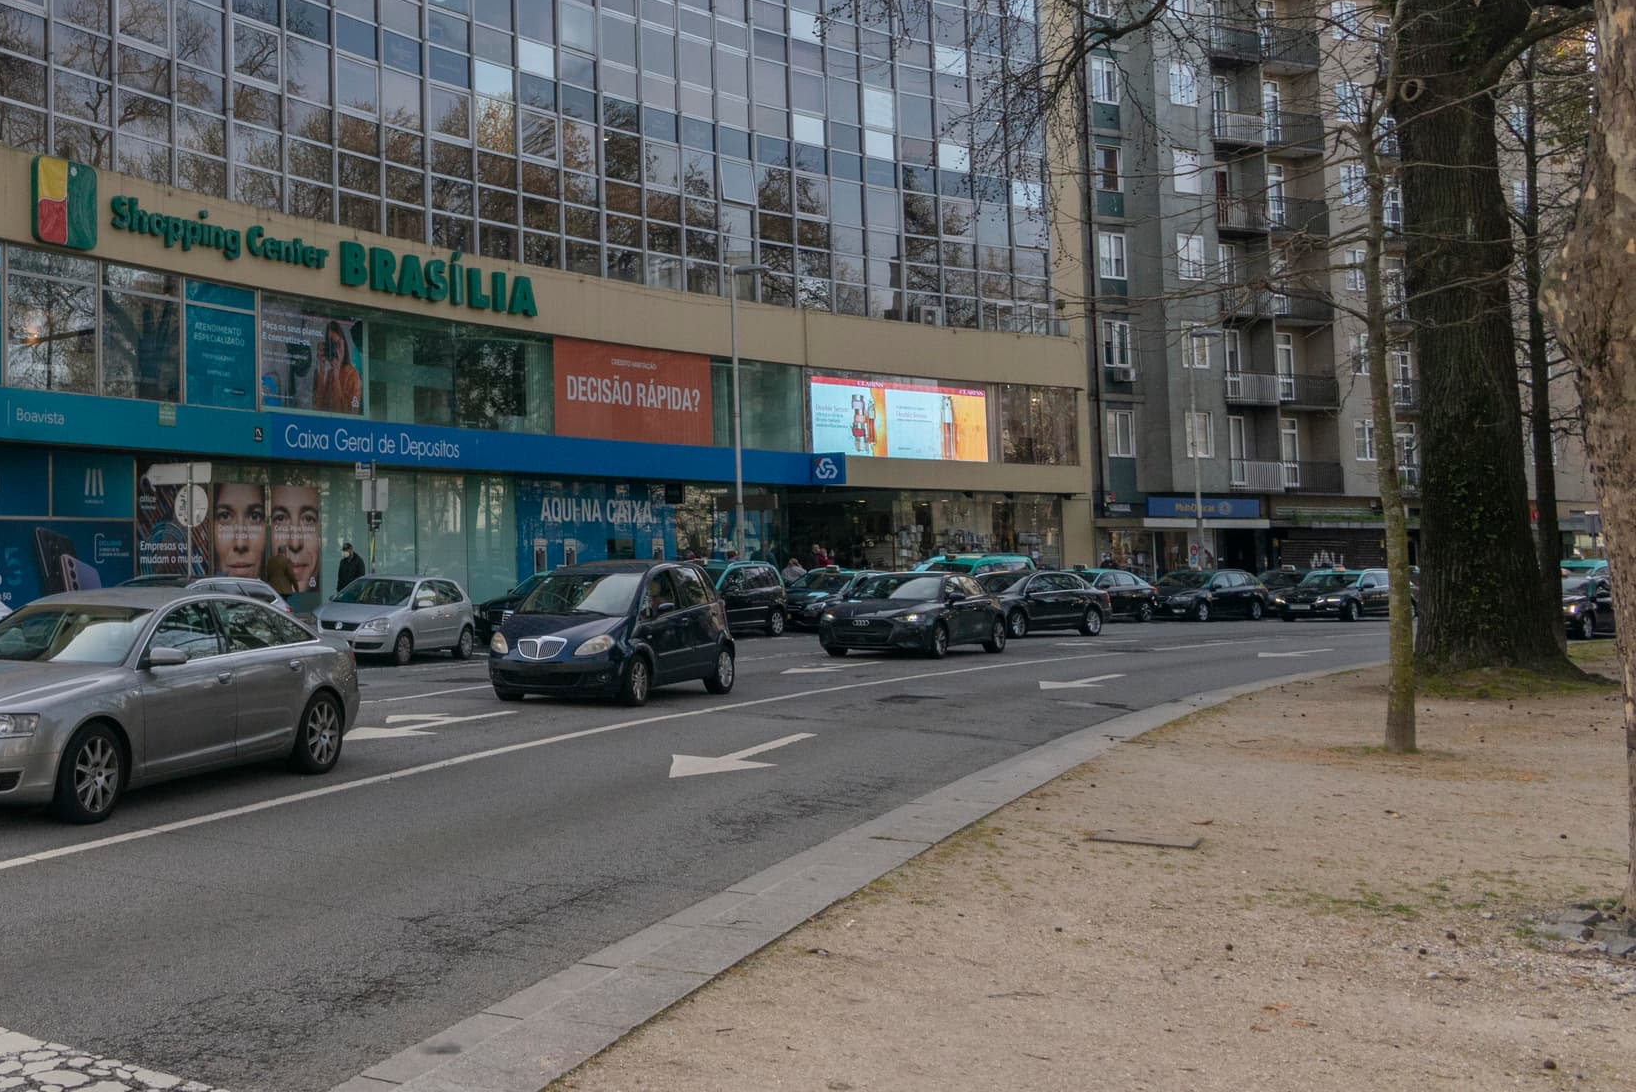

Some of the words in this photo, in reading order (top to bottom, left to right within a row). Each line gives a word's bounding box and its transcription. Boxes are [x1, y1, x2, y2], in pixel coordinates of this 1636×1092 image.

[111, 195, 241, 259] Shopping
[247, 225, 329, 269] Center
[339, 241, 539, 317] BRASÍLIA
[194, 321, 242, 337] ATENDIMENTO
[566, 375, 632, 406] DECISÃO
[636, 379, 701, 412] RÁPIDA?
[16, 408, 64, 425] Boavista
[285, 423, 329, 450] Caixa
[335, 428, 374, 453] Geral
[378, 434, 396, 454] de
[541, 497, 577, 523] AQUI
[582, 499, 602, 523] NA
[139, 540, 177, 553] Empresas
[140, 554, 169, 564] mudam
[171, 555, 177, 564] o
